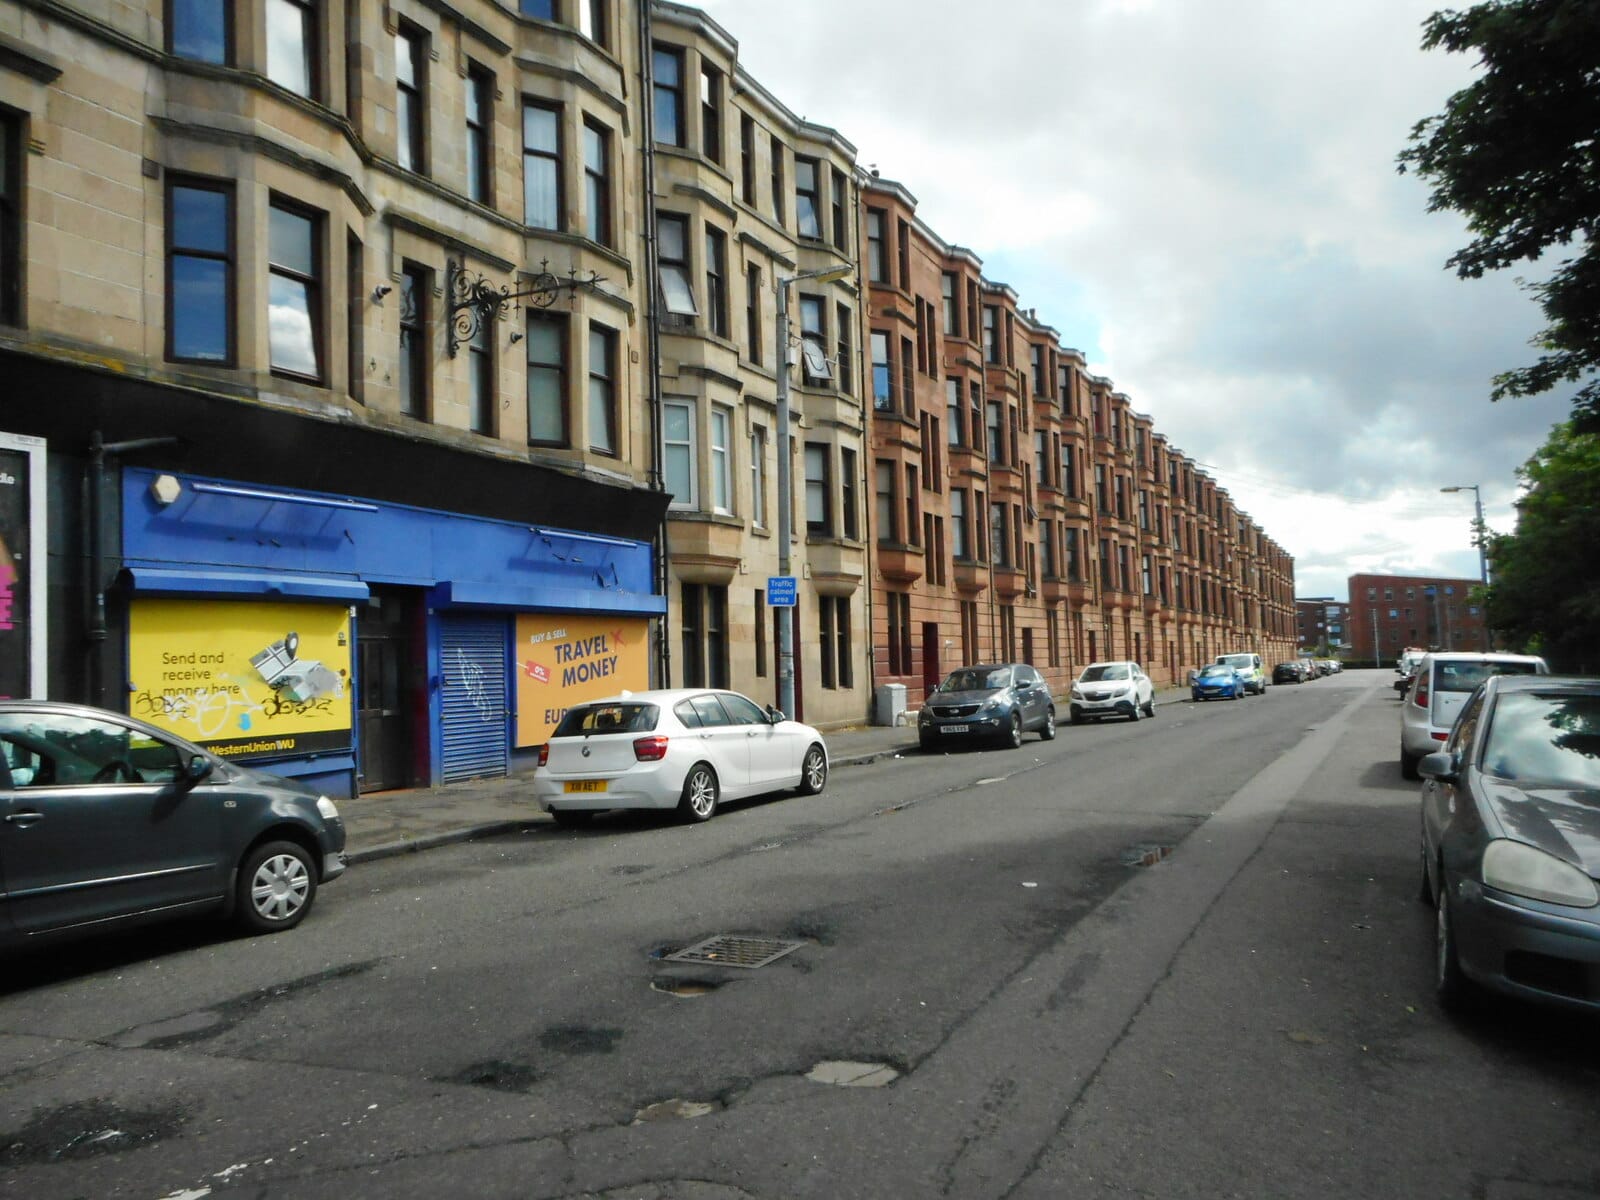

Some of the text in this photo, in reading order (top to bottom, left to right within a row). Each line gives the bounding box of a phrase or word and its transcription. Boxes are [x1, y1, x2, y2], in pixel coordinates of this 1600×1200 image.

[771, 579, 793, 588] Traffic
[530, 628, 567, 645] BUY & SELL
[554, 634, 609, 664] TRAVEL
[162, 651, 224, 665] Send and
[162, 668, 211, 681] receive
[562, 655, 618, 688] MONEY
[211, 683, 240, 695] here
